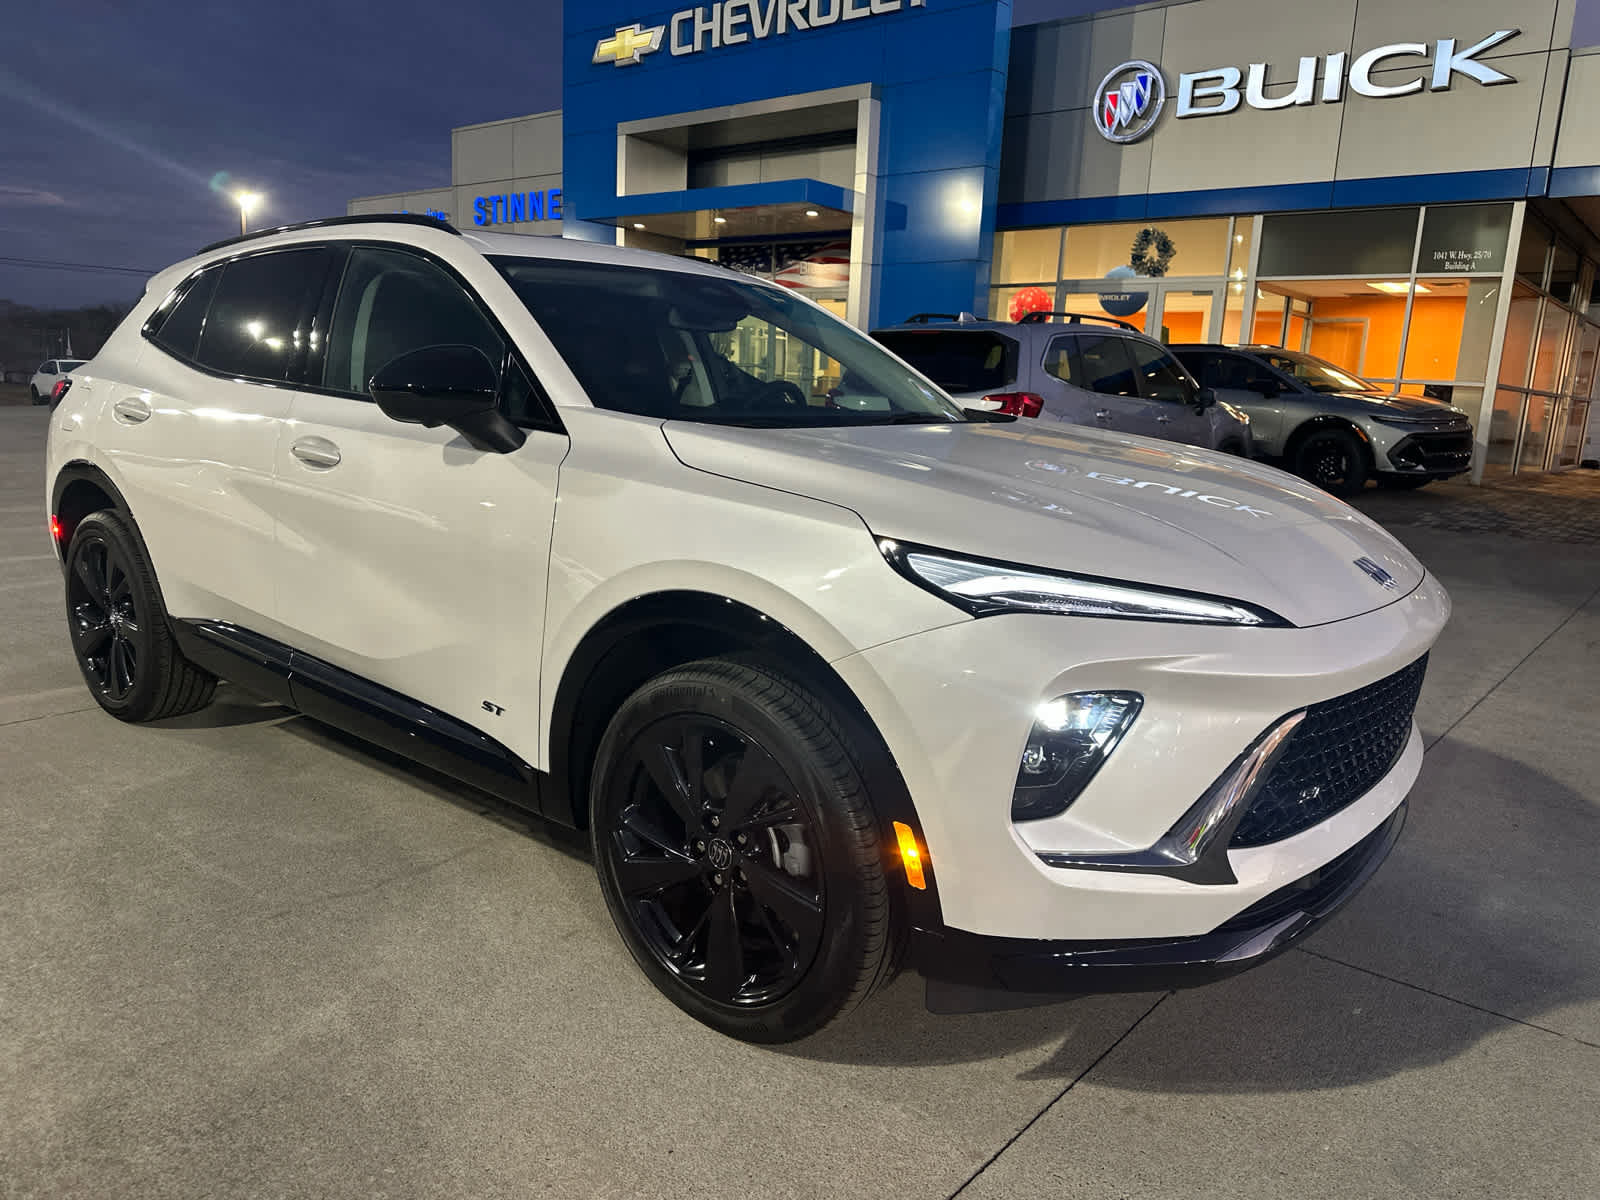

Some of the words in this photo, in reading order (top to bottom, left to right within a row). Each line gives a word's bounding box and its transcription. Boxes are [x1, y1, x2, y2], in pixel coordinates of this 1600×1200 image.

[670, 0, 926, 56] CHEVROL
[1176, 28, 1522, 118] BUICK
[473, 188, 561, 226] STINNE
[1433, 250, 1447, 260] 1041
[1449, 250, 1457, 260] W.
[1445, 261, 1469, 271] Building
[1470, 261, 1476, 270] A
[481, 700, 506, 716] ST
